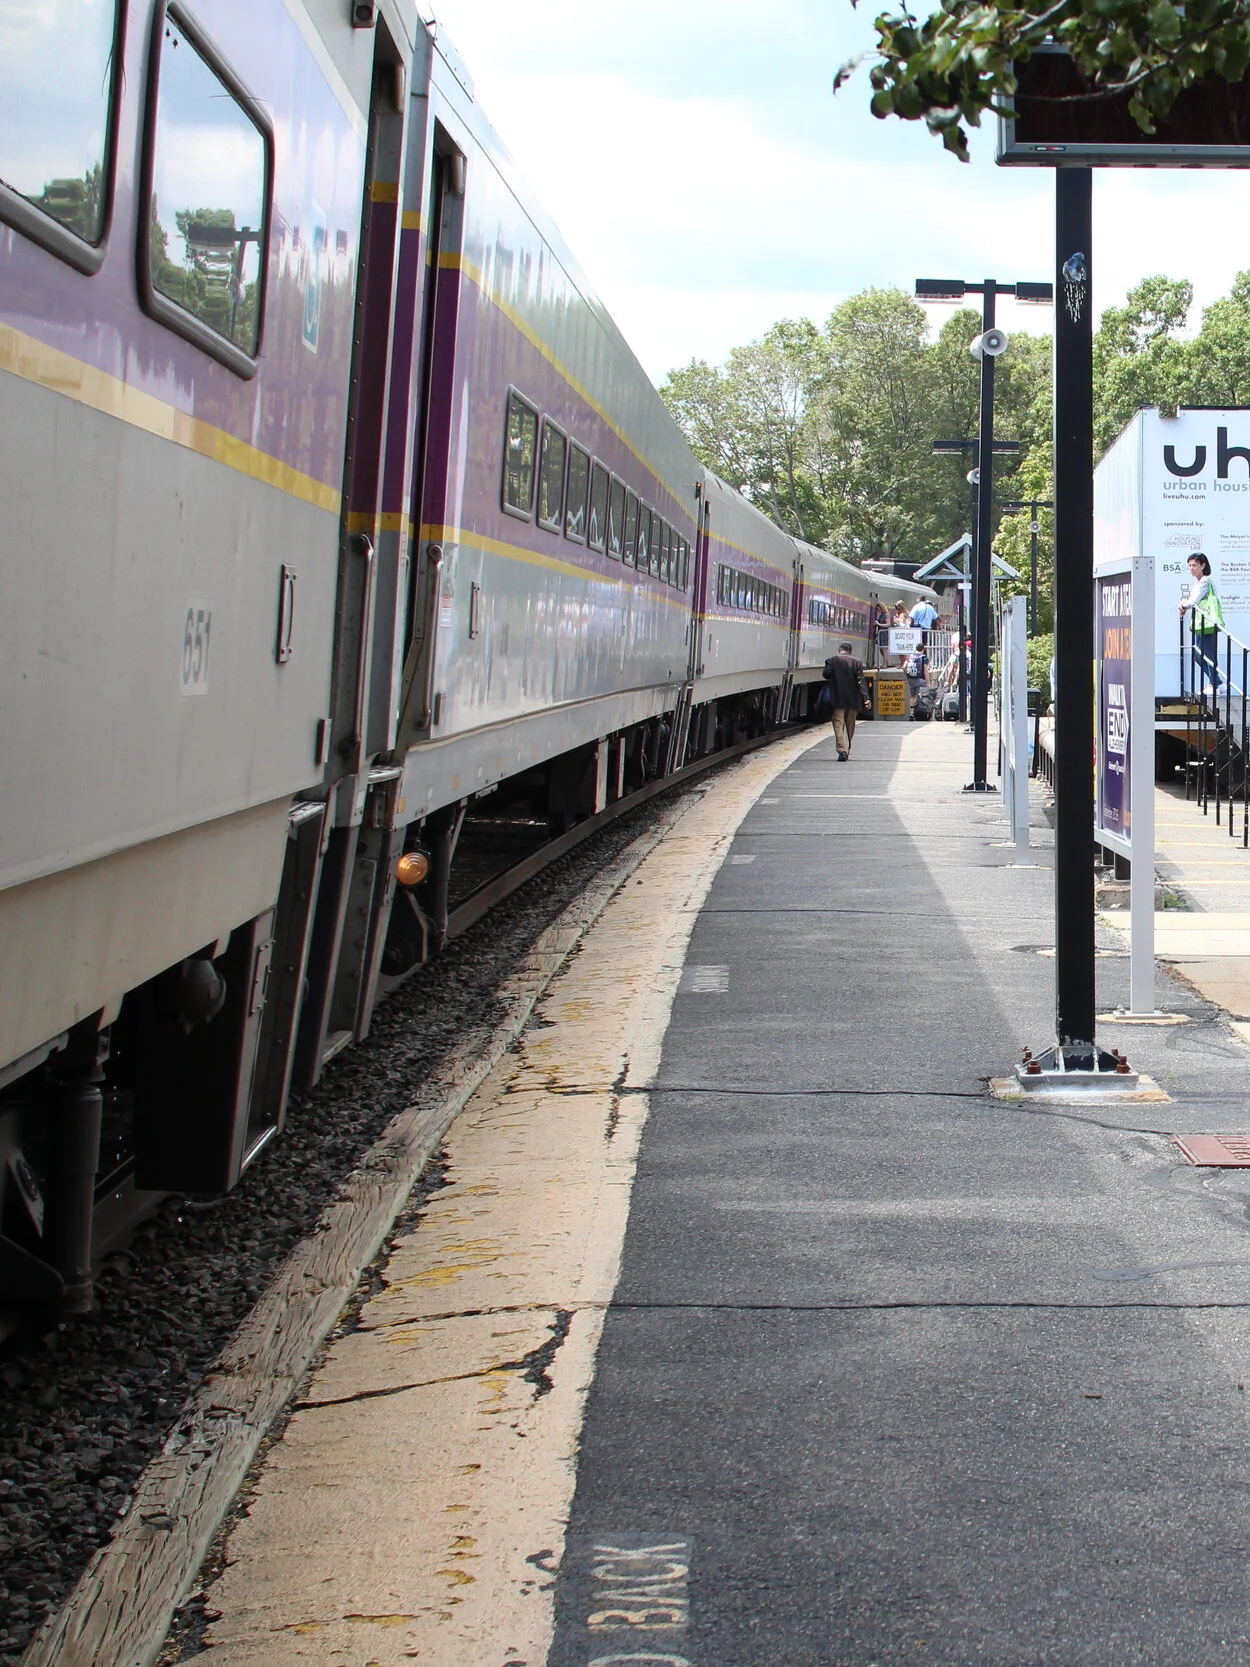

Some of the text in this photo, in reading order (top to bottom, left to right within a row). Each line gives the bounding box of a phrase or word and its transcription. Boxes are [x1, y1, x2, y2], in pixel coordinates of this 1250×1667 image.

[1163, 478, 1207, 491] urban
[1102, 585, 1119, 617] START
[183, 607, 212, 685] 651
[1103, 627, 1120, 659] JOIN
[587, 1542, 689, 1630] BACK
